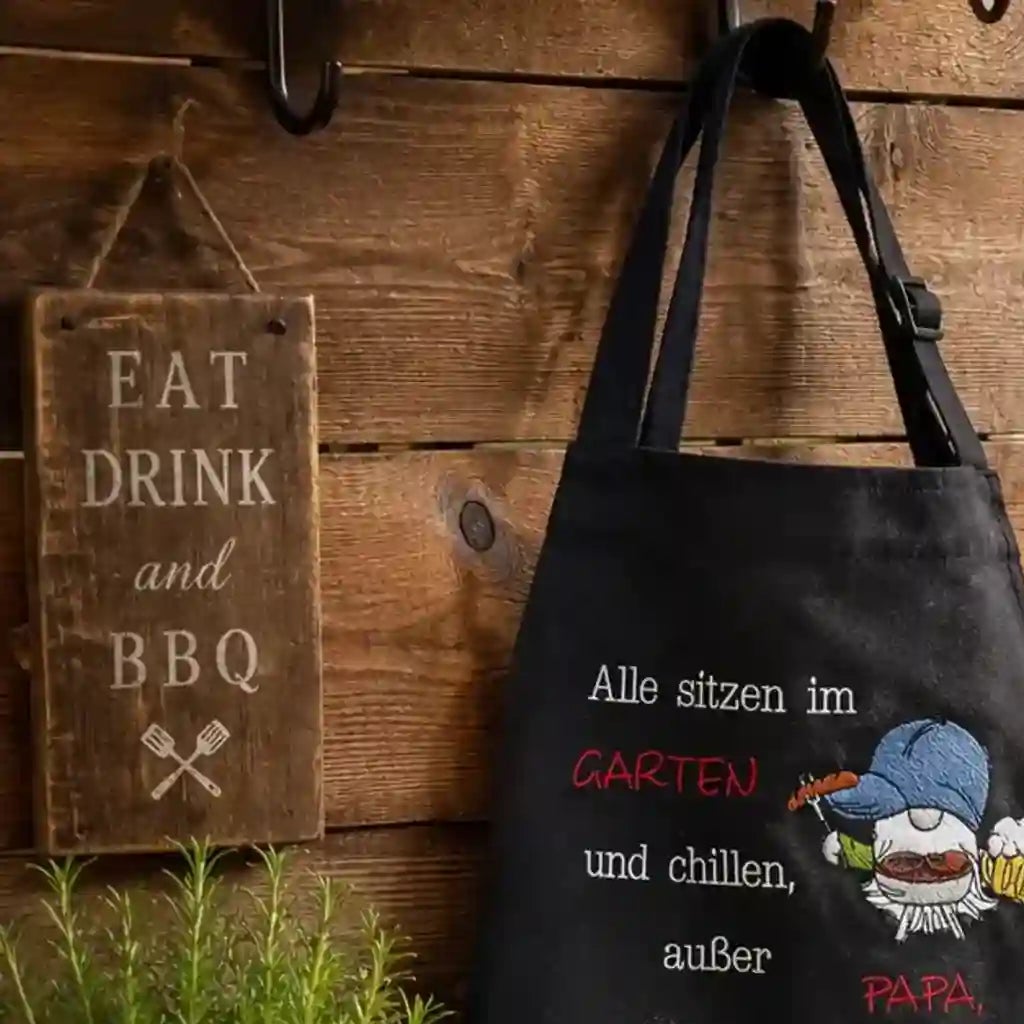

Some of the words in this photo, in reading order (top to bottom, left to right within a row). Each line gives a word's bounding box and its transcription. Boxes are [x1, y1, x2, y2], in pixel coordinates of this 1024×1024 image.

[107, 350, 247, 409] EAT
[81, 448, 276, 507] DRINK
[134, 537, 236, 592] and
[109, 628, 260, 693] BBQ
[588, 664, 659, 705] Alle
[677, 671, 786, 713] sitzen
[806, 677, 857, 715] im
[572, 749, 759, 798] GARTEN
[584, 844, 649, 882] und
[668, 848, 797, 895] chillen,
[663, 936, 772, 974] außer
[861, 973, 985, 1016] PAPA,
